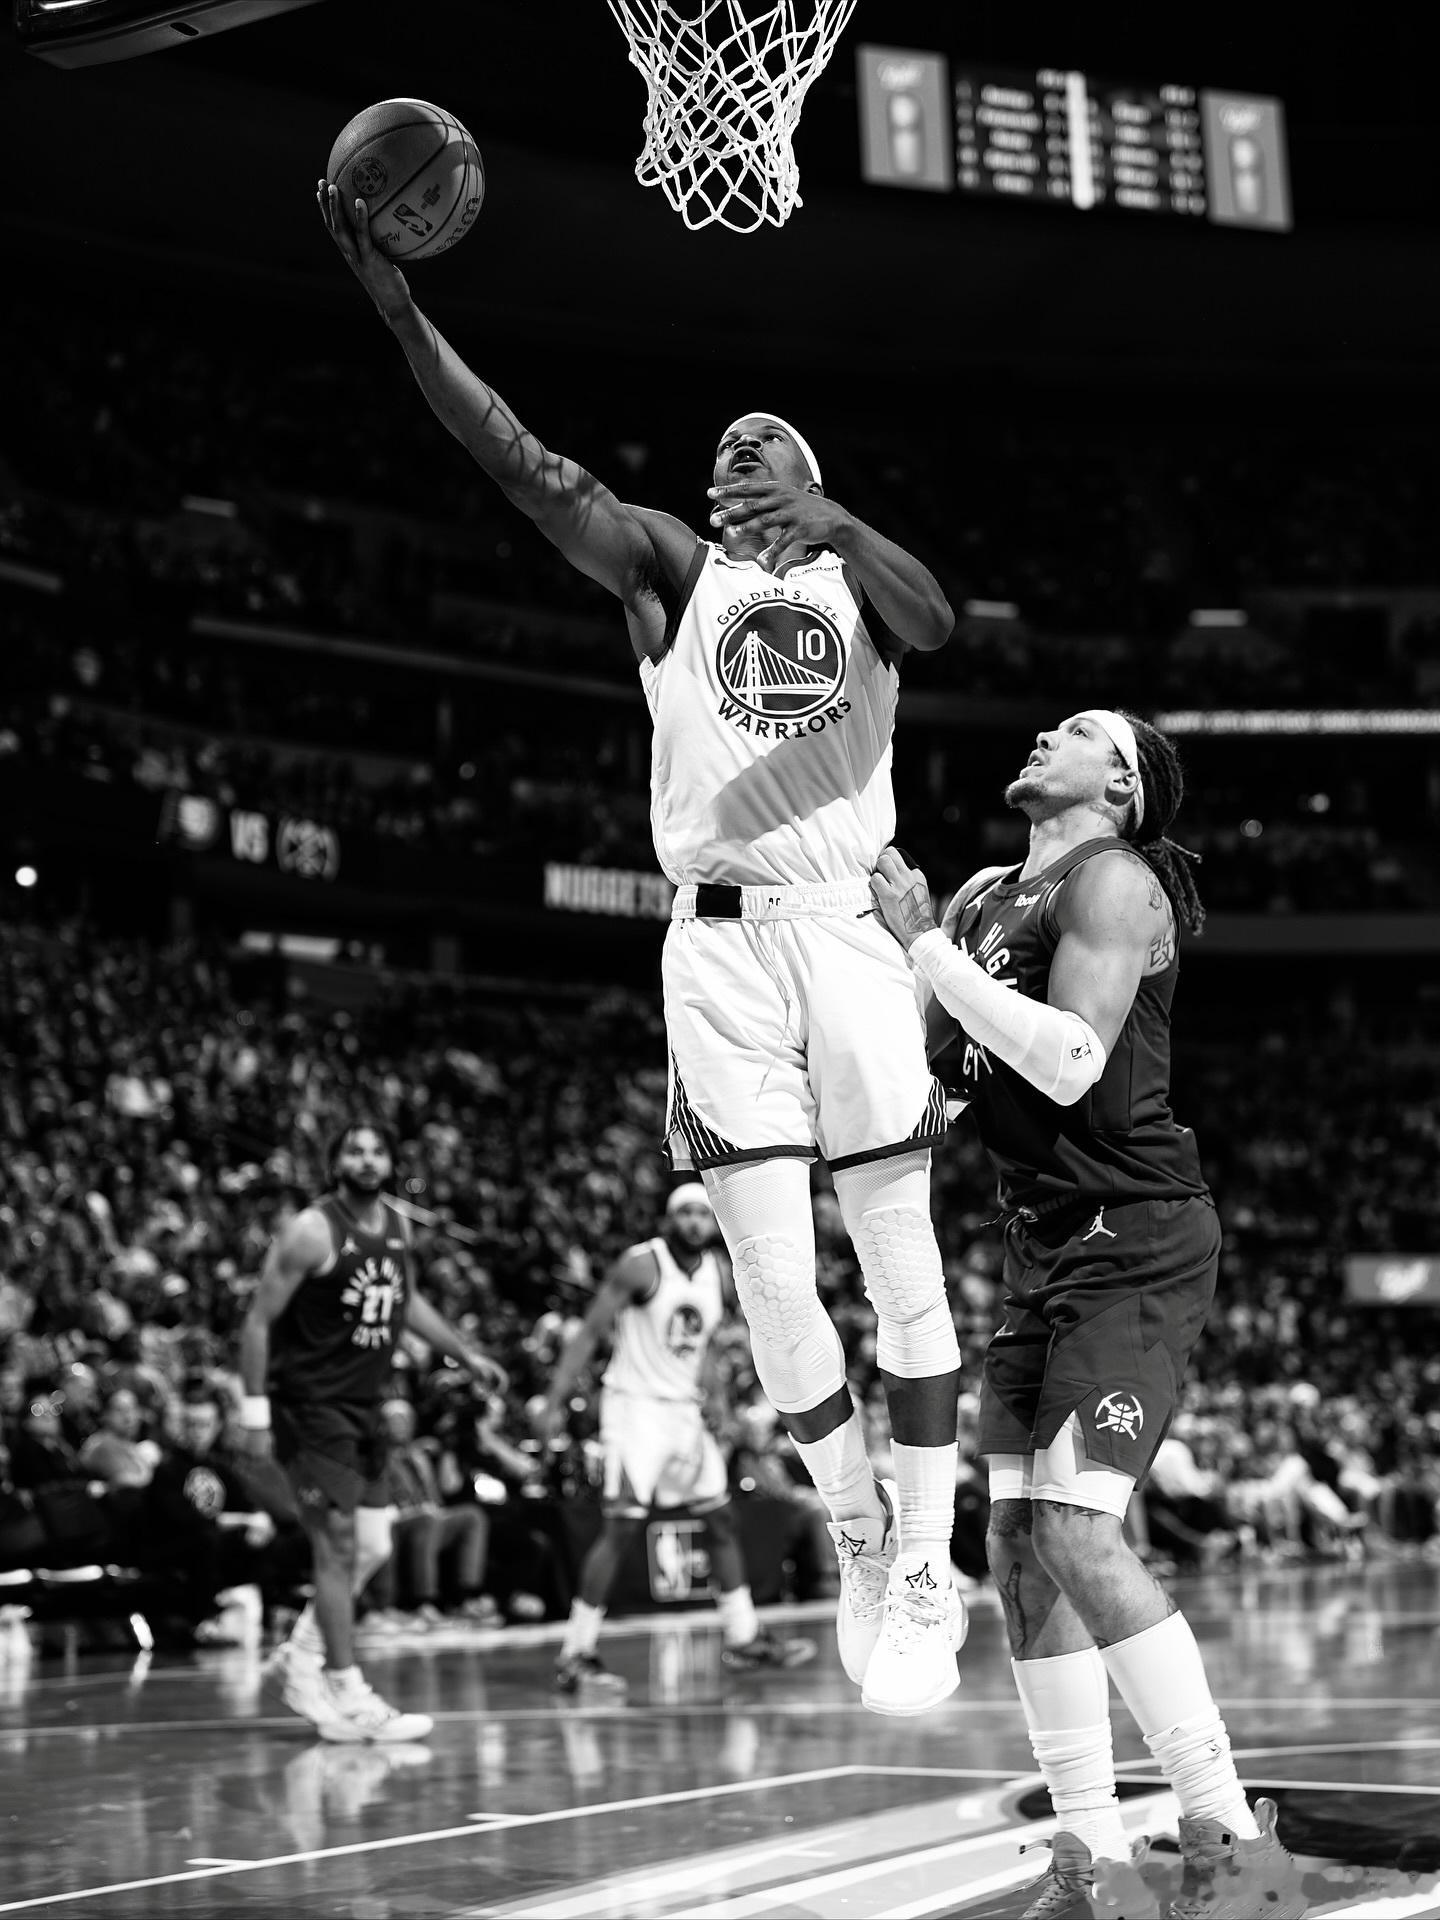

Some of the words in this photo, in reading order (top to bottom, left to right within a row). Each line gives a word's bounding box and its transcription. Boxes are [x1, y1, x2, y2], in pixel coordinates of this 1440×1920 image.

[717, 587, 785, 626] GOLDEN
[792, 590, 839, 621] SATE
[797, 628, 826, 661] 10
[717, 696, 852, 740] WARRIORS
[361, 1285, 393, 1323] 21
